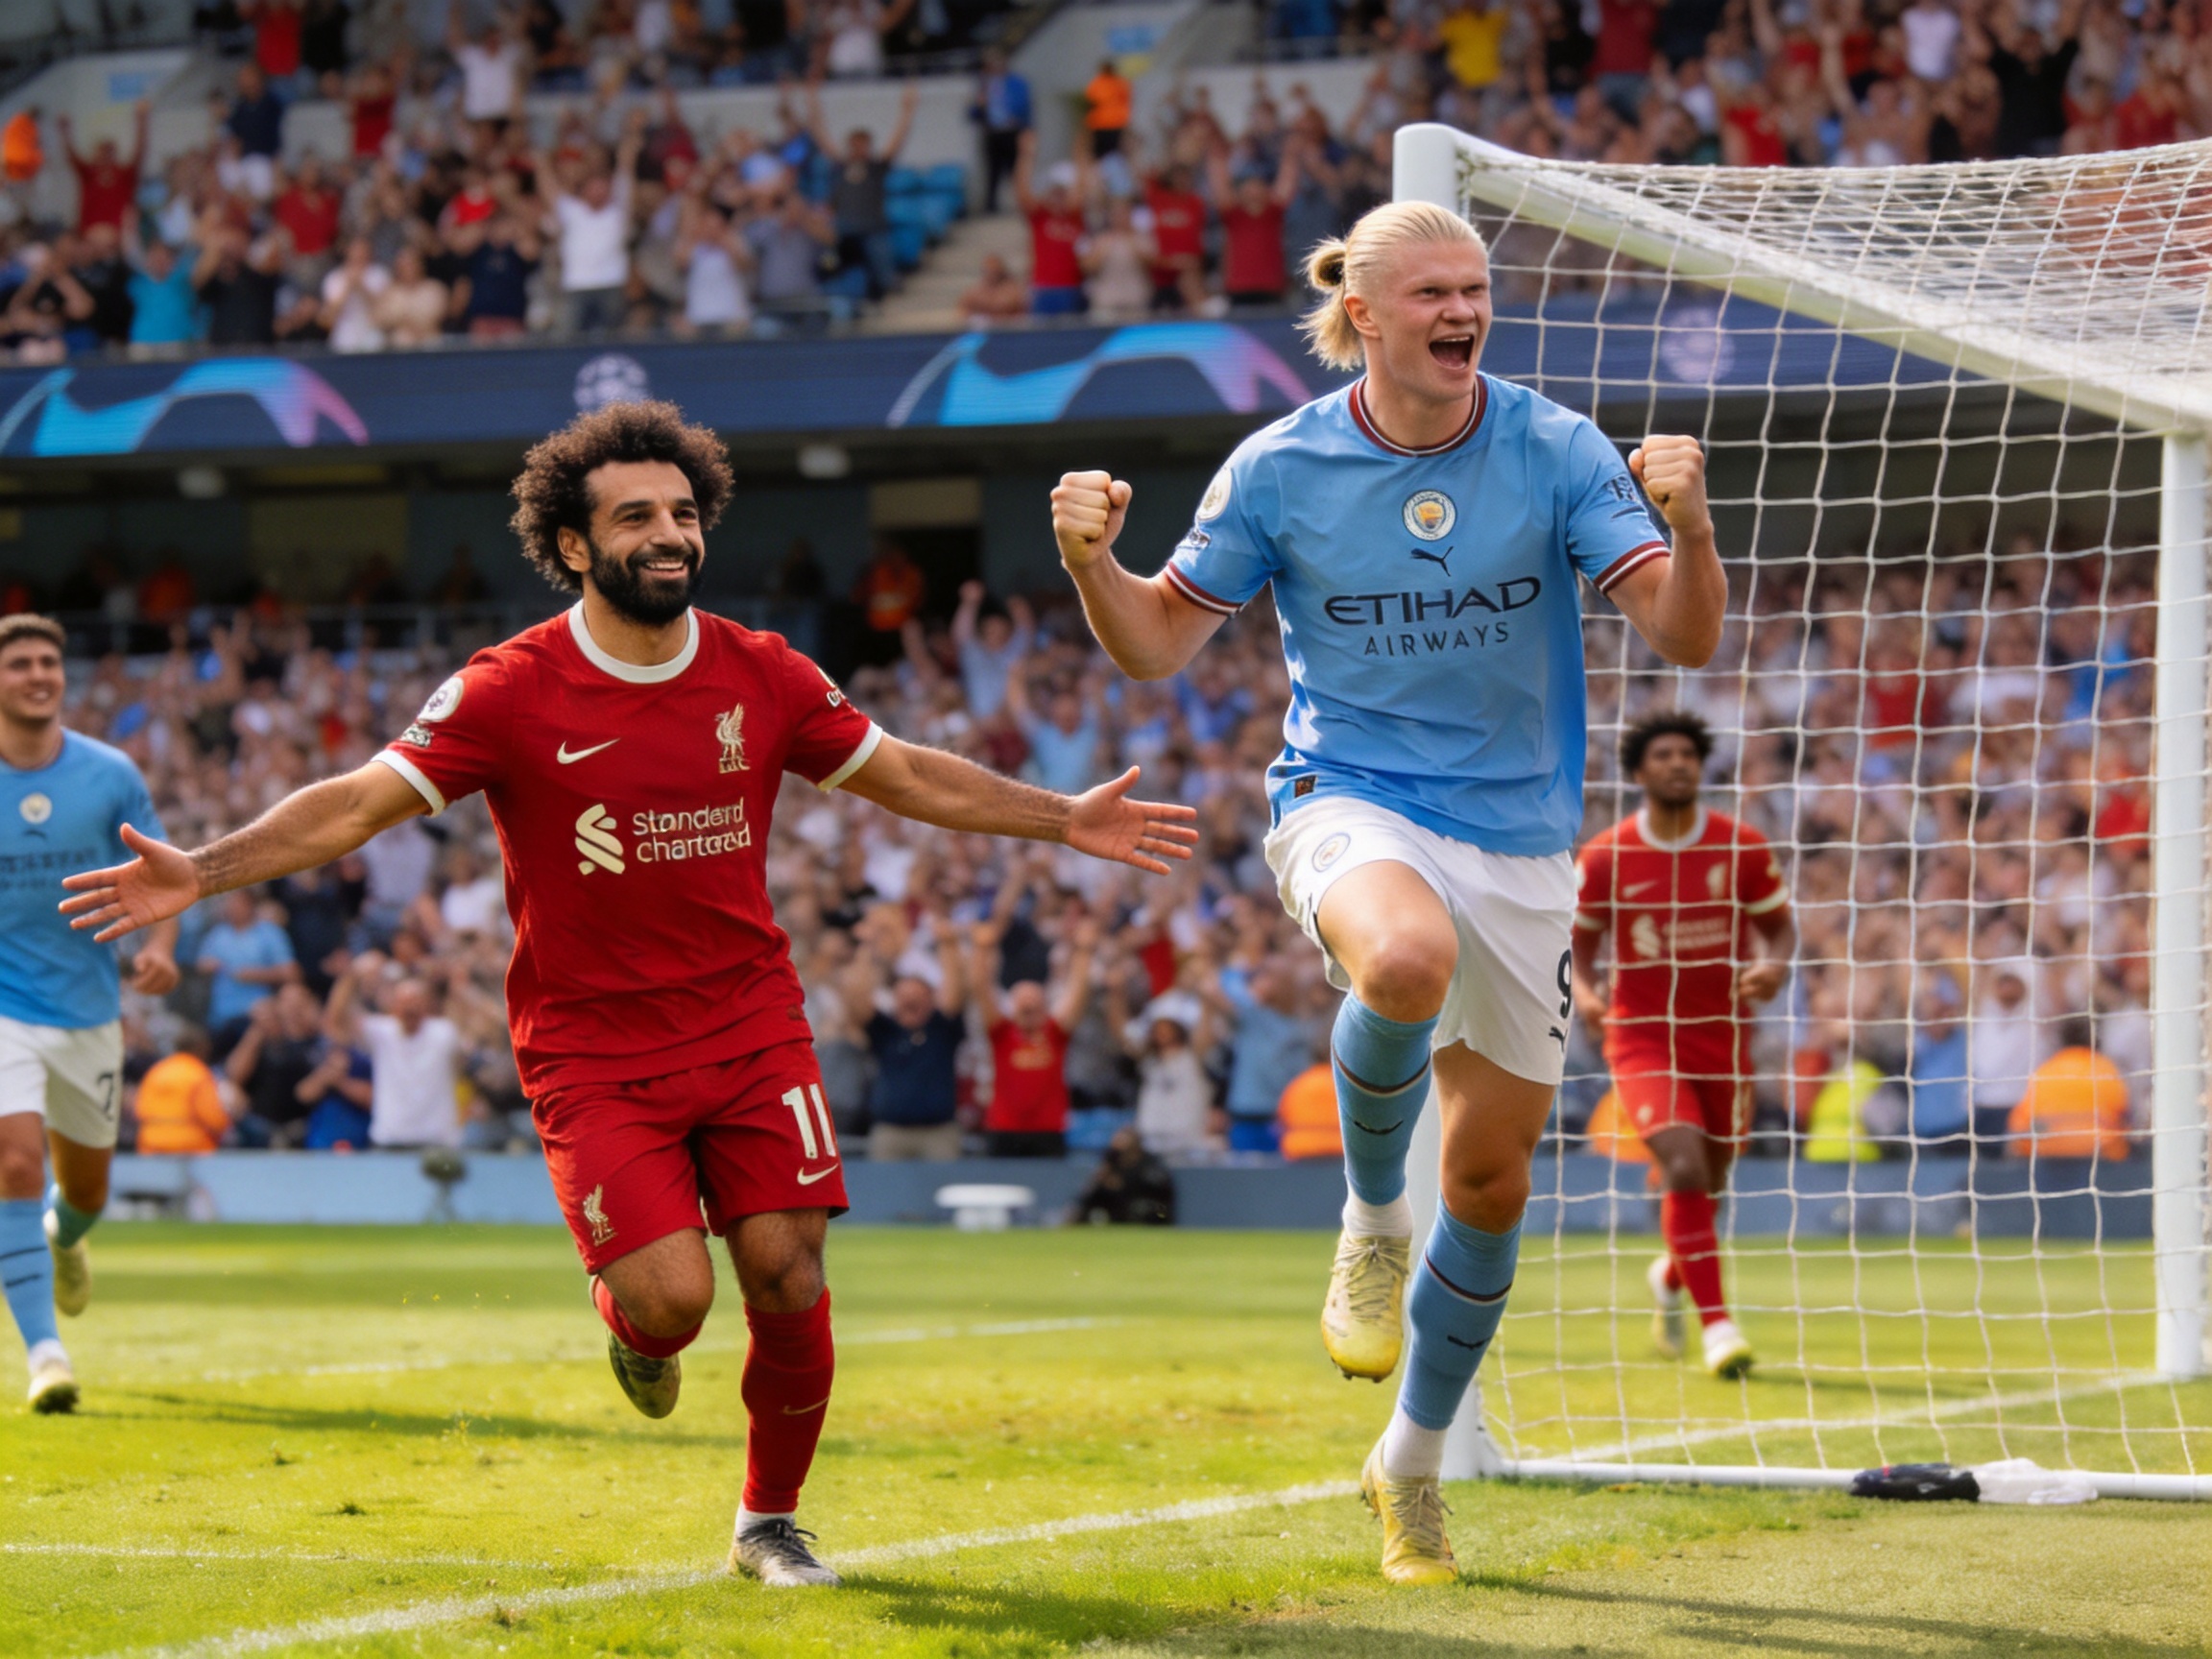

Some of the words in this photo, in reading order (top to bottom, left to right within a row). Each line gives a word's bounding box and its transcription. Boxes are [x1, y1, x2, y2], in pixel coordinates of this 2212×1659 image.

[1324, 576, 1541, 625] ETIHAD
[1364, 622, 1509, 656] AIRWAYS
[1557, 949, 1572, 1020] 9
[781, 1083, 836, 1159] 11
